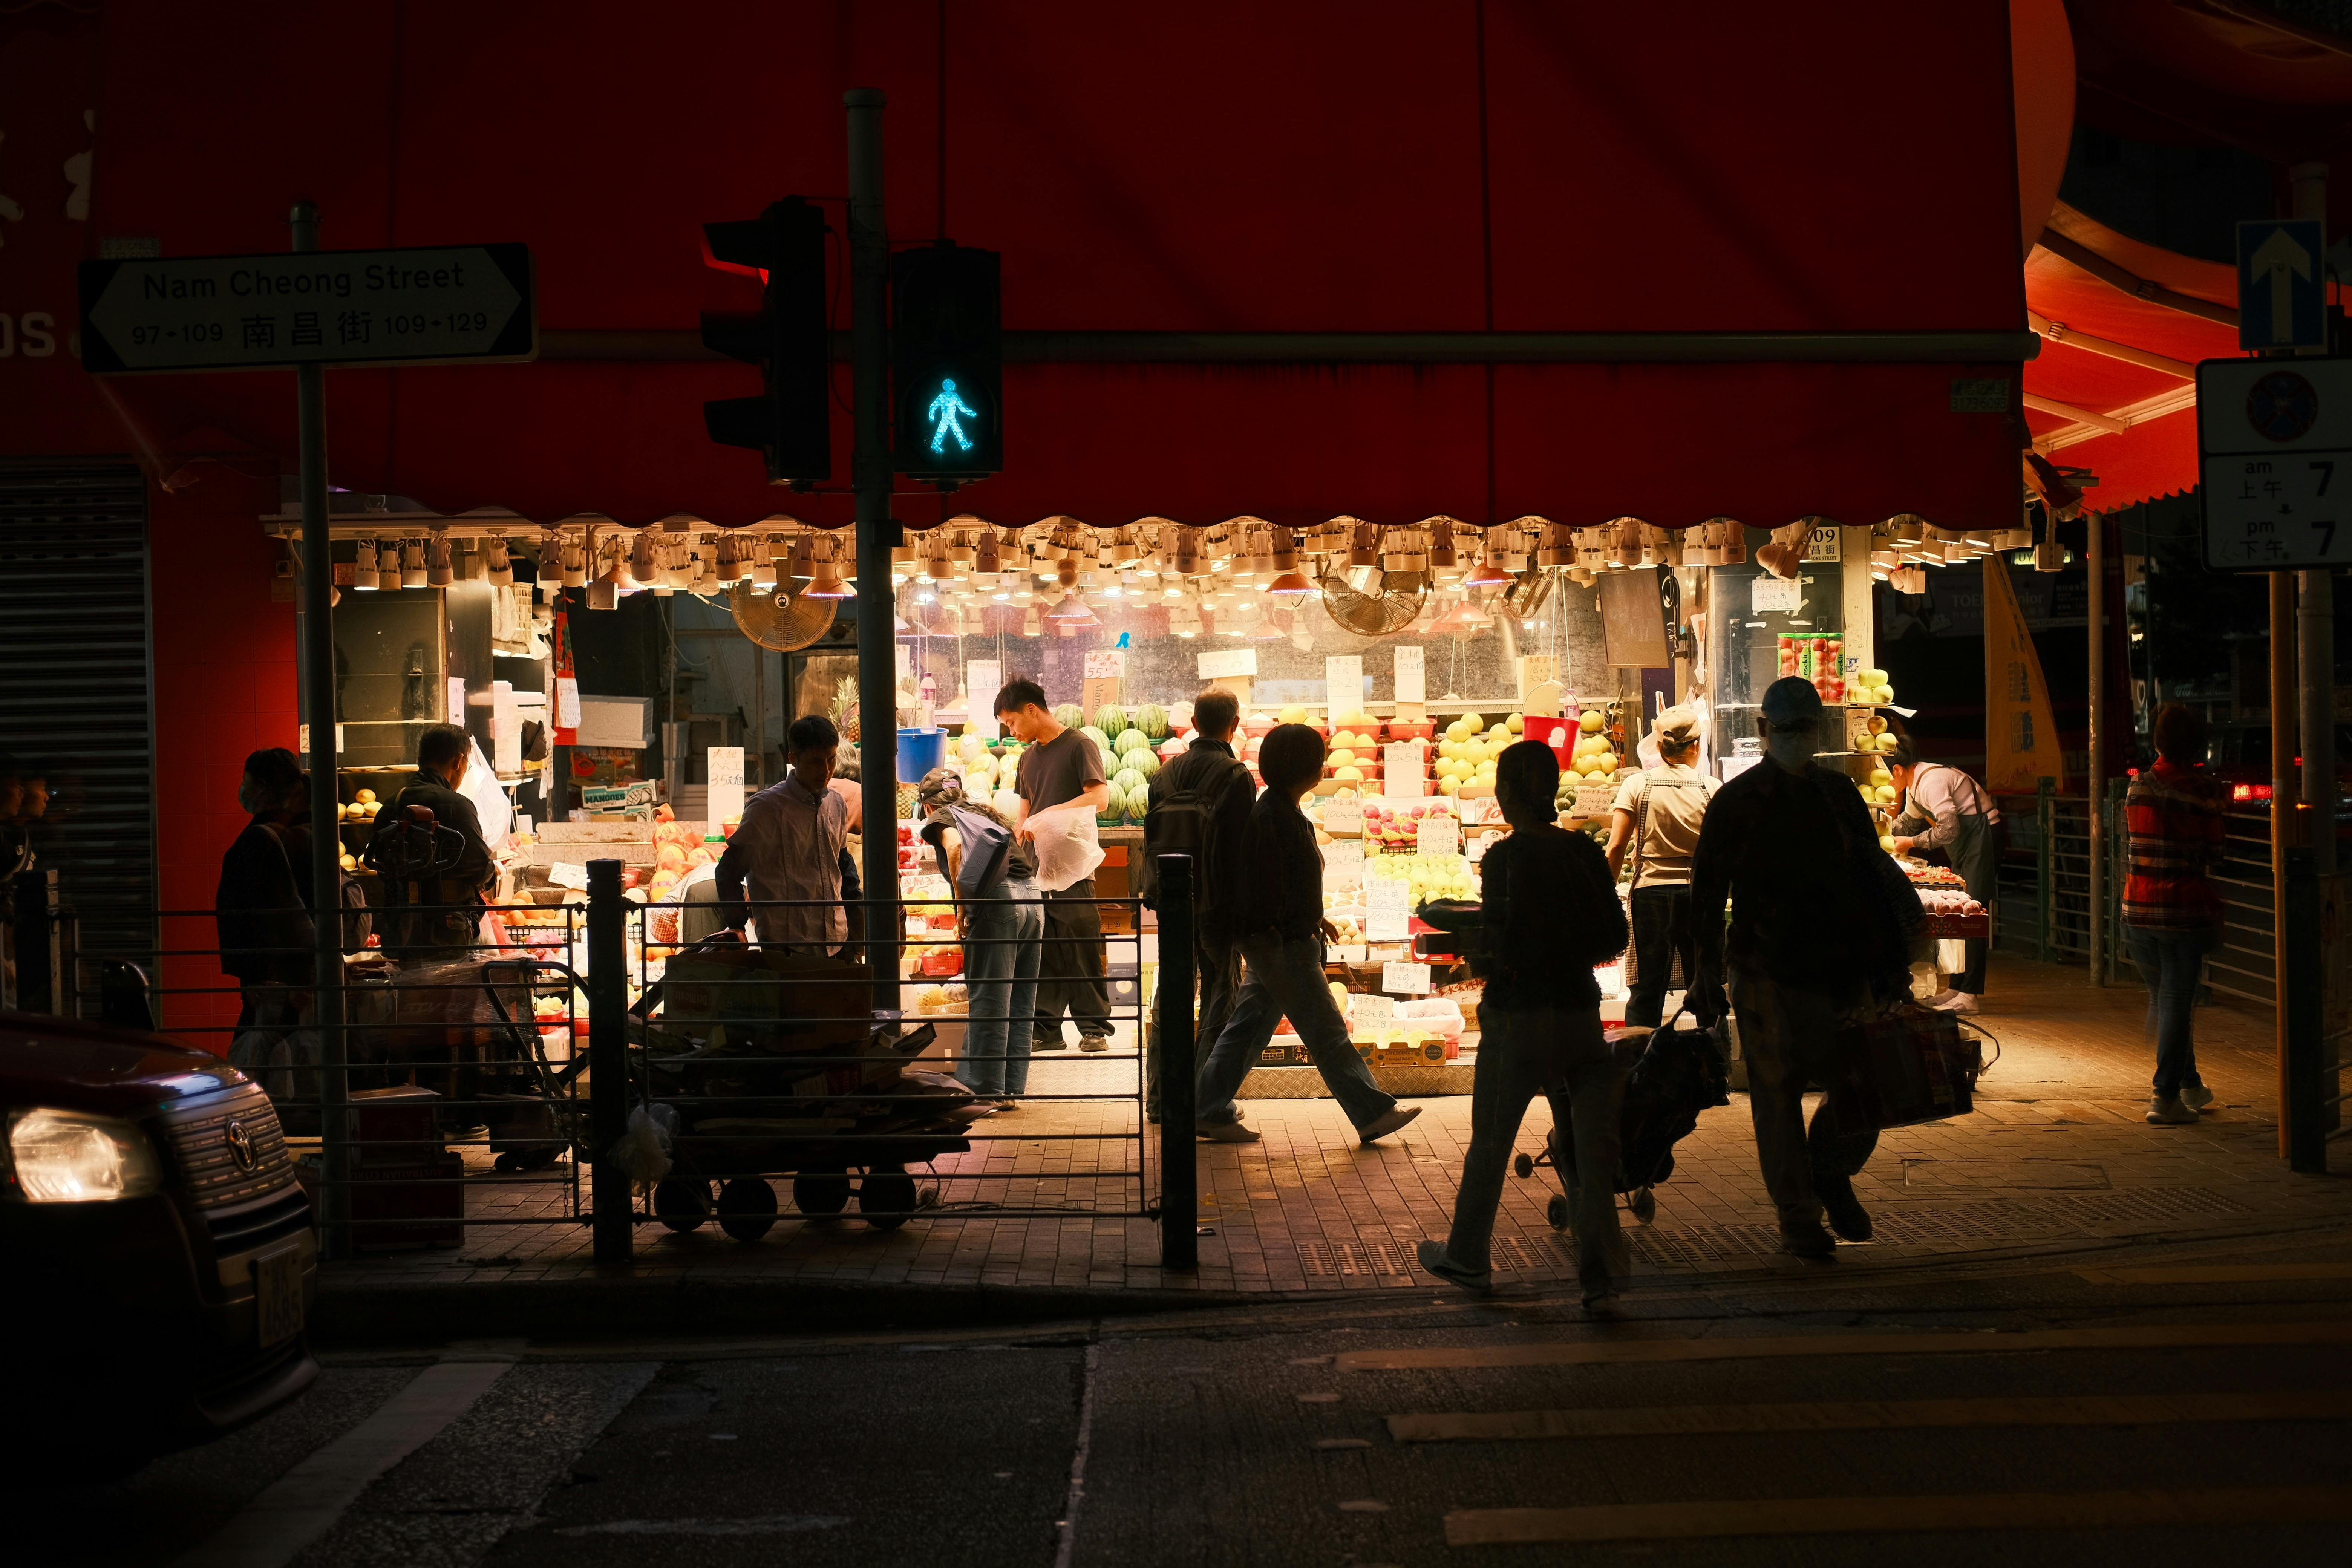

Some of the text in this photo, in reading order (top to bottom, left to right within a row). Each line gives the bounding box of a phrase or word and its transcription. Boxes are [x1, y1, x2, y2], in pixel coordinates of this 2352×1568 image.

[144, 263, 464, 299] Nam Cheong Street
[241, 310, 372, 349] 南昌街
[2245, 462, 2272, 474] am
[2309, 461, 2334, 497] 7
[2237, 479, 2282, 499] 上午
[1808, 529, 1835, 543] 09
[2247, 521, 2275, 537] pm
[2310, 521, 2336, 556] 7
[2239, 538, 2284, 559] 下午
[585, 793, 625, 804] MANGOES
[1324, 855, 1360, 865] 00元5個
[383, 1168, 443, 1178] AUSTRALIAN
